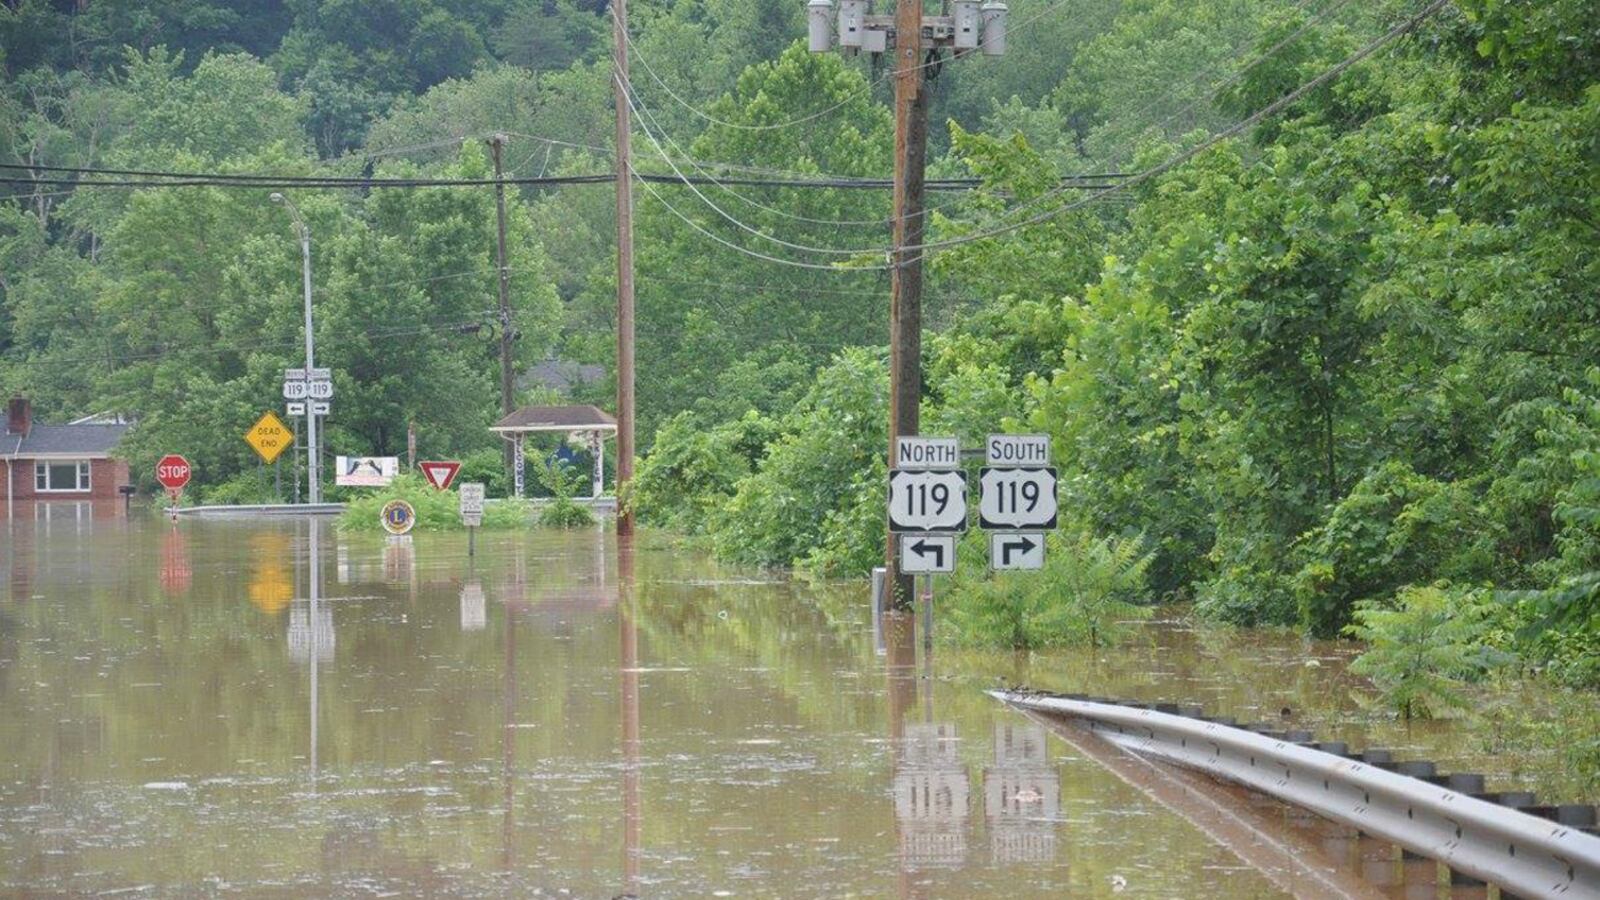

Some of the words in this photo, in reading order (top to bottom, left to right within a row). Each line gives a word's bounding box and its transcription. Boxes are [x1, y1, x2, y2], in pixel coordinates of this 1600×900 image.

[288, 384, 302, 395] 119
[313, 384, 328, 395] 119
[257, 427, 281, 436] DEAD
[260, 439, 277, 448] END
[991, 440, 1046, 460] SOUTH
[900, 442, 956, 462] NORTH
[159, 465, 188, 479] STOP
[906, 483, 949, 516] 119
[996, 480, 1040, 513] 119
